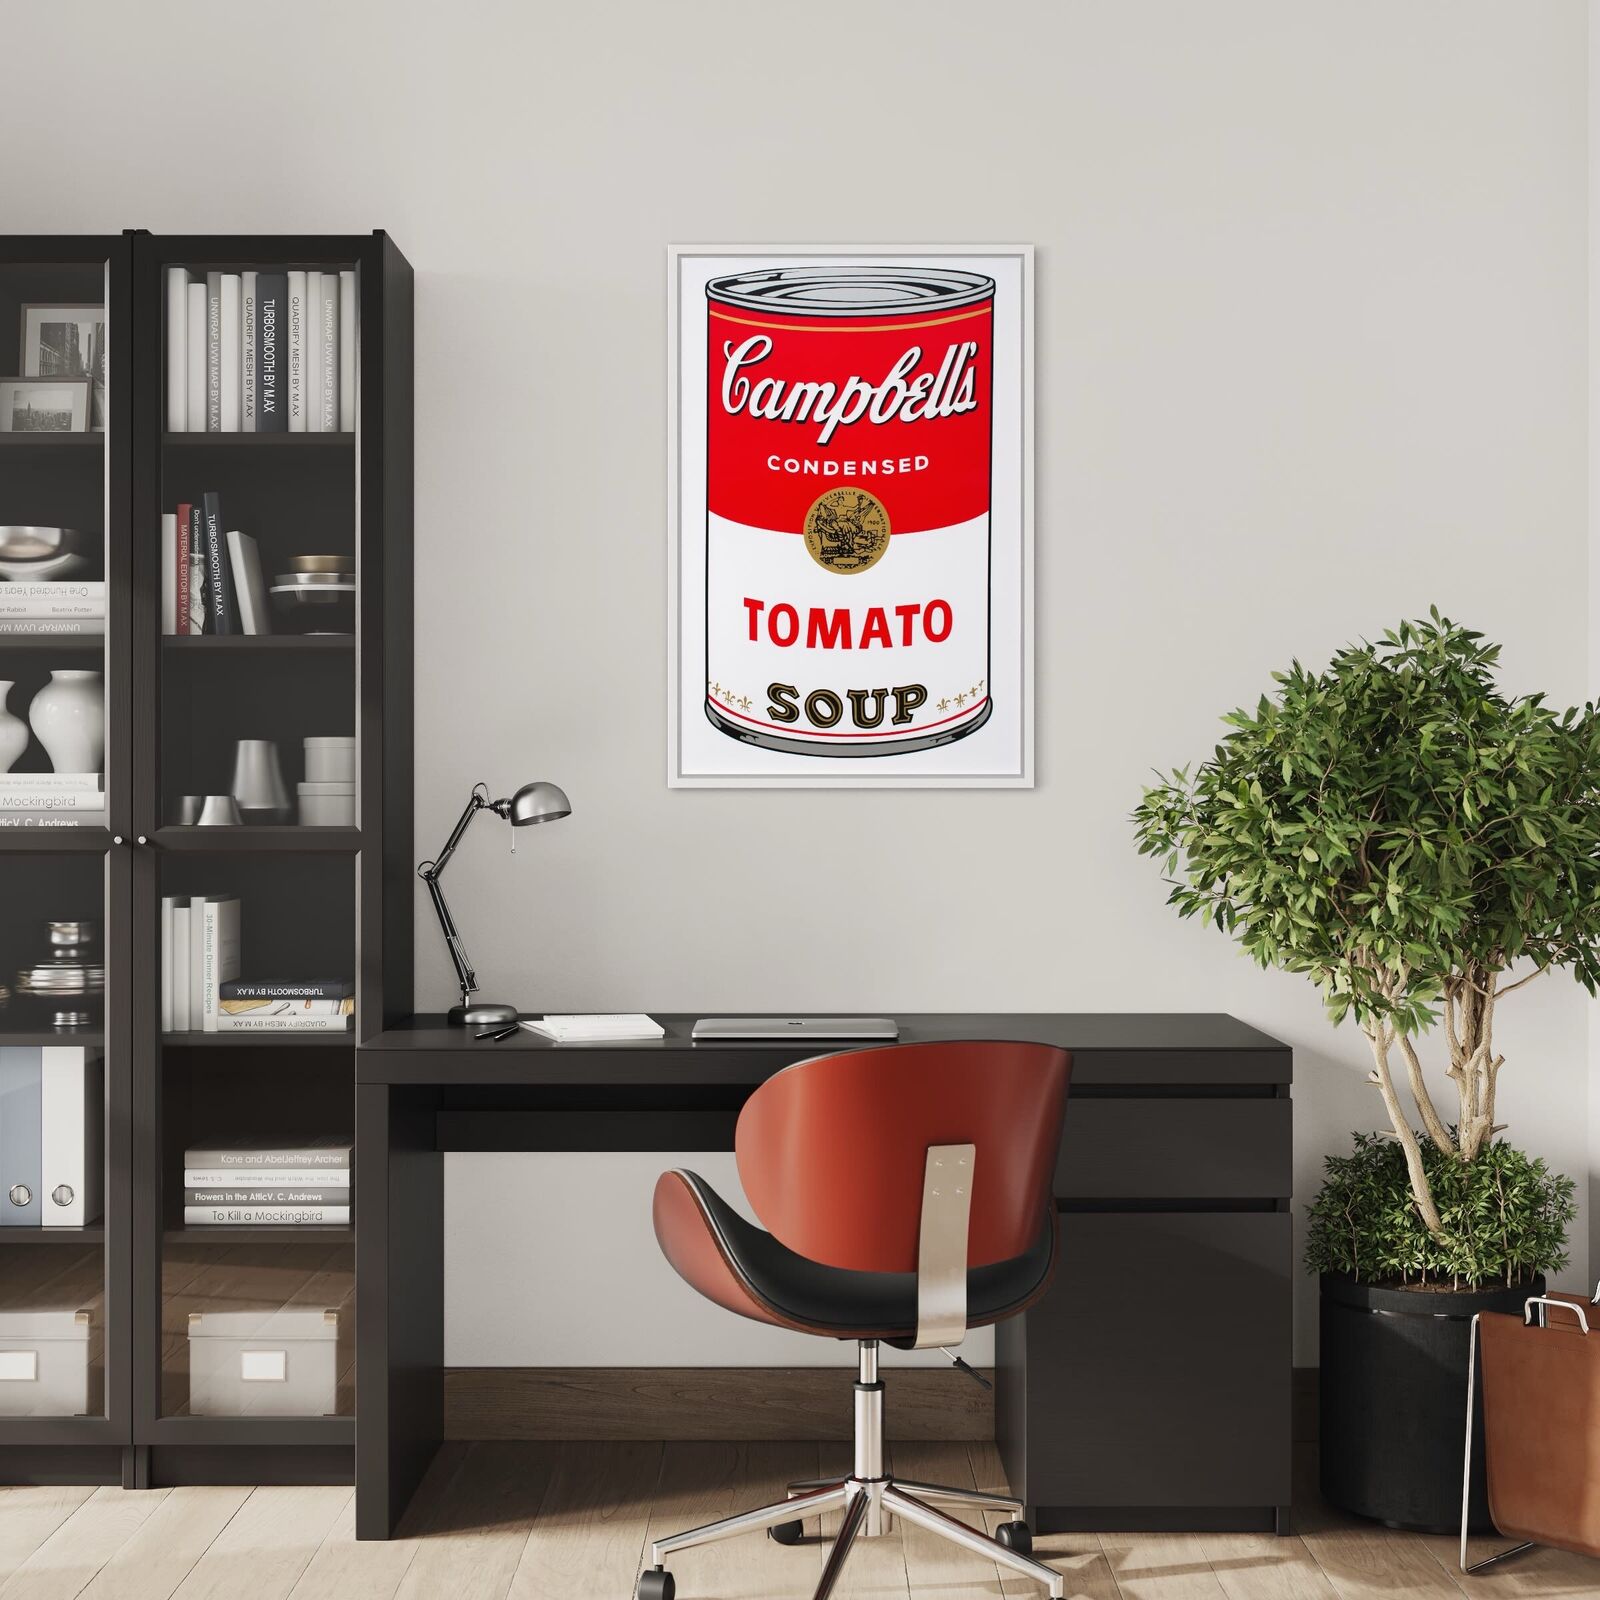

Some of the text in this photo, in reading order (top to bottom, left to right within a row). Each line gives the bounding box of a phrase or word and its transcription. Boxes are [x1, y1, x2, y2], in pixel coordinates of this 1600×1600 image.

[210, 297, 219, 339] UNWRAP
[245, 297, 254, 346] QUADRIFY
[292, 296, 300, 346] QUADRIFY
[325, 299, 333, 341] UNWRAP
[210, 342, 219, 365] UVW
[245, 348, 254, 376] MESH
[263, 299, 276, 413] TURBOSMOOTH BY M.AX
[292, 348, 300, 376] MESH
[325, 342, 333, 365] UVW
[210, 366, 219, 388] MAP
[245, 379, 254, 391] BY
[292, 378, 300, 391] BY
[325, 366, 333, 387] MAP
[210, 390, 219, 403] BY
[325, 389, 333, 402] BY
[721, 335, 978, 446] Campbell's
[767, 455, 929, 477] CONDENSED
[180, 524, 188, 562] MATERIAL
[208, 514, 224, 616] TURBOSMOOTH BY M.AX
[180, 564, 188, 593] EDITOR
[5, 586, 26, 596] Years
[30, 587, 67, 597] Hundred
[69, 587, 88, 597] One
[180, 594, 188, 605] BY
[13, 623, 36, 632] UVW
[38, 623, 80, 632] UNWRAP
[743, 597, 953, 650] TOMATO
[766, 682, 928, 729] SOUP
[2, 796, 76, 808] Mockingbird
[205, 983, 213, 1014] Recipes
[256, 987, 266, 996] BY
[267, 987, 324, 996] TURBOSMOOTH
[253, 1020, 264, 1028] BY
[265, 1020, 287, 1028] MESH
[287, 1020, 327, 1028] QUADRIFY
[220, 1154, 243, 1164] Kane
[245, 1154, 263, 1164] and
[314, 1154, 343, 1164] Archer
[194, 1192, 224, 1201] Flowers
[225, 1192, 233, 1201] in
[234, 1192, 247, 1201] the
[277, 1192, 286, 1201] C.
[287, 1192, 322, 1201] Andrews
[212, 1210, 323, 1224] To Kill a Mockingbird
